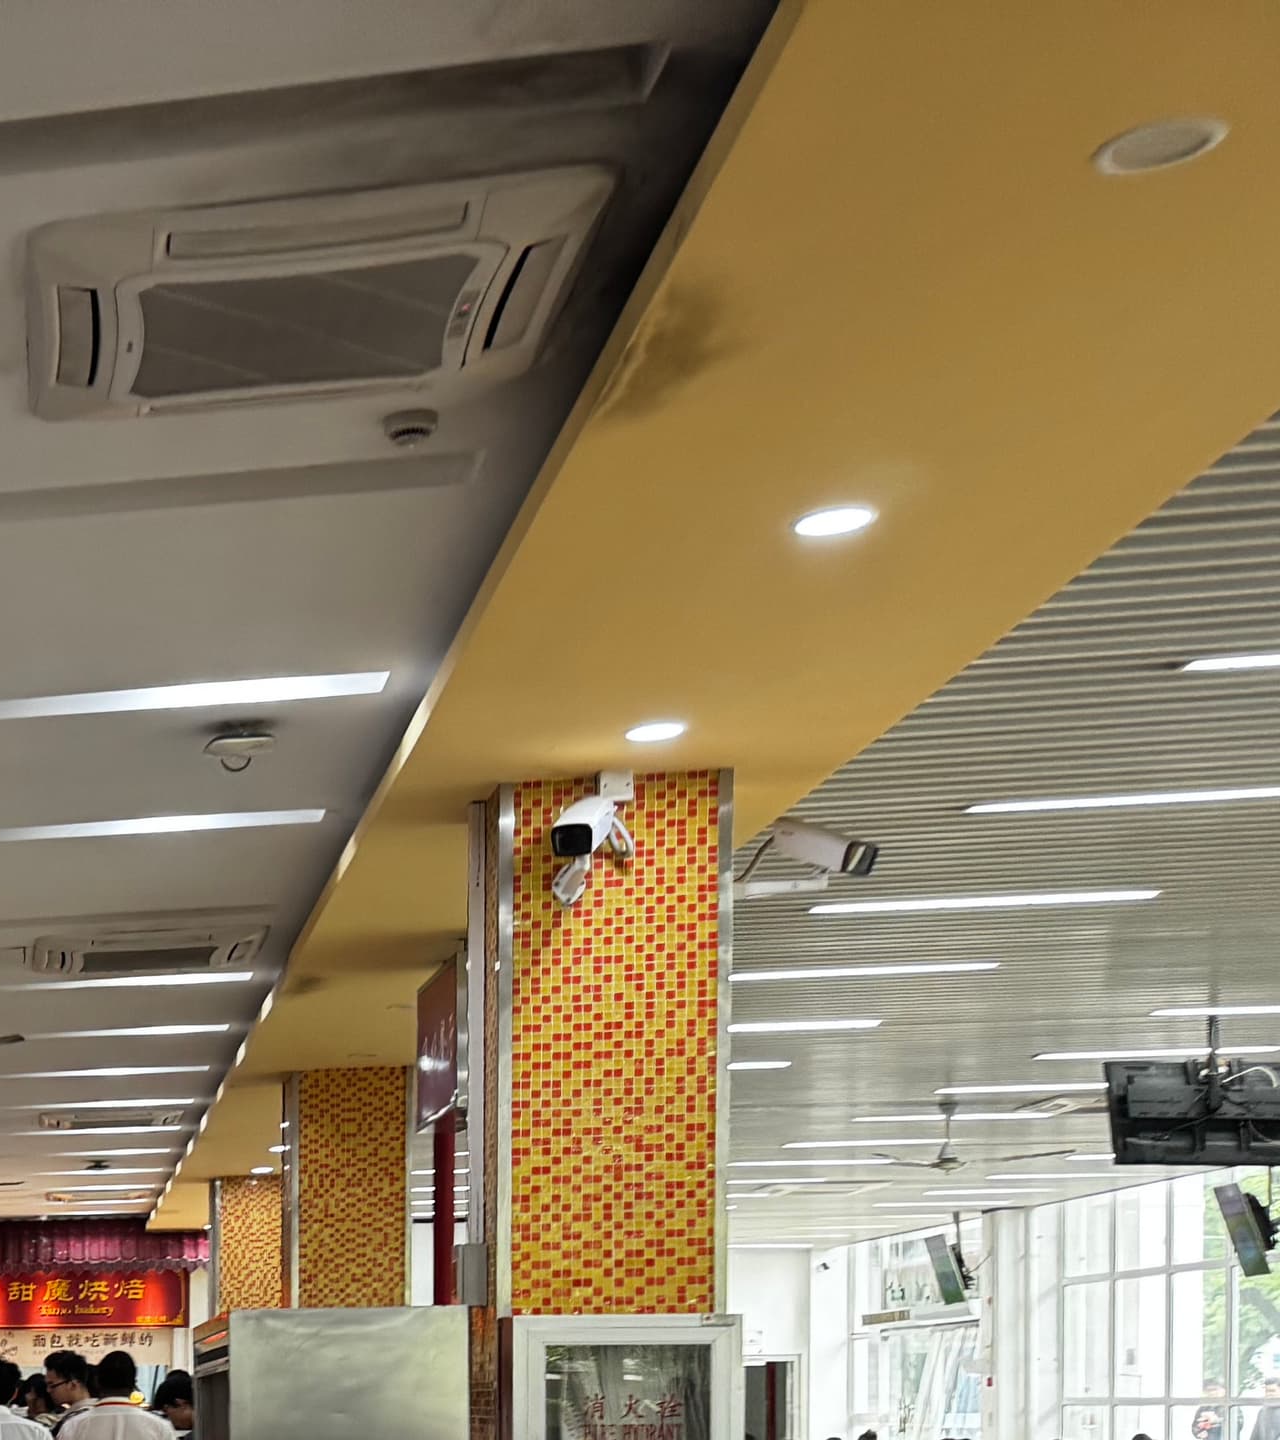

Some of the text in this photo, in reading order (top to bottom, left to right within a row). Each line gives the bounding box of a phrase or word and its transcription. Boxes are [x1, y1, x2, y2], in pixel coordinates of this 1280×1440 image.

[7, 1278, 147, 1302] 甜魔烘焙
[583, 1393, 683, 1420] 消火栓
